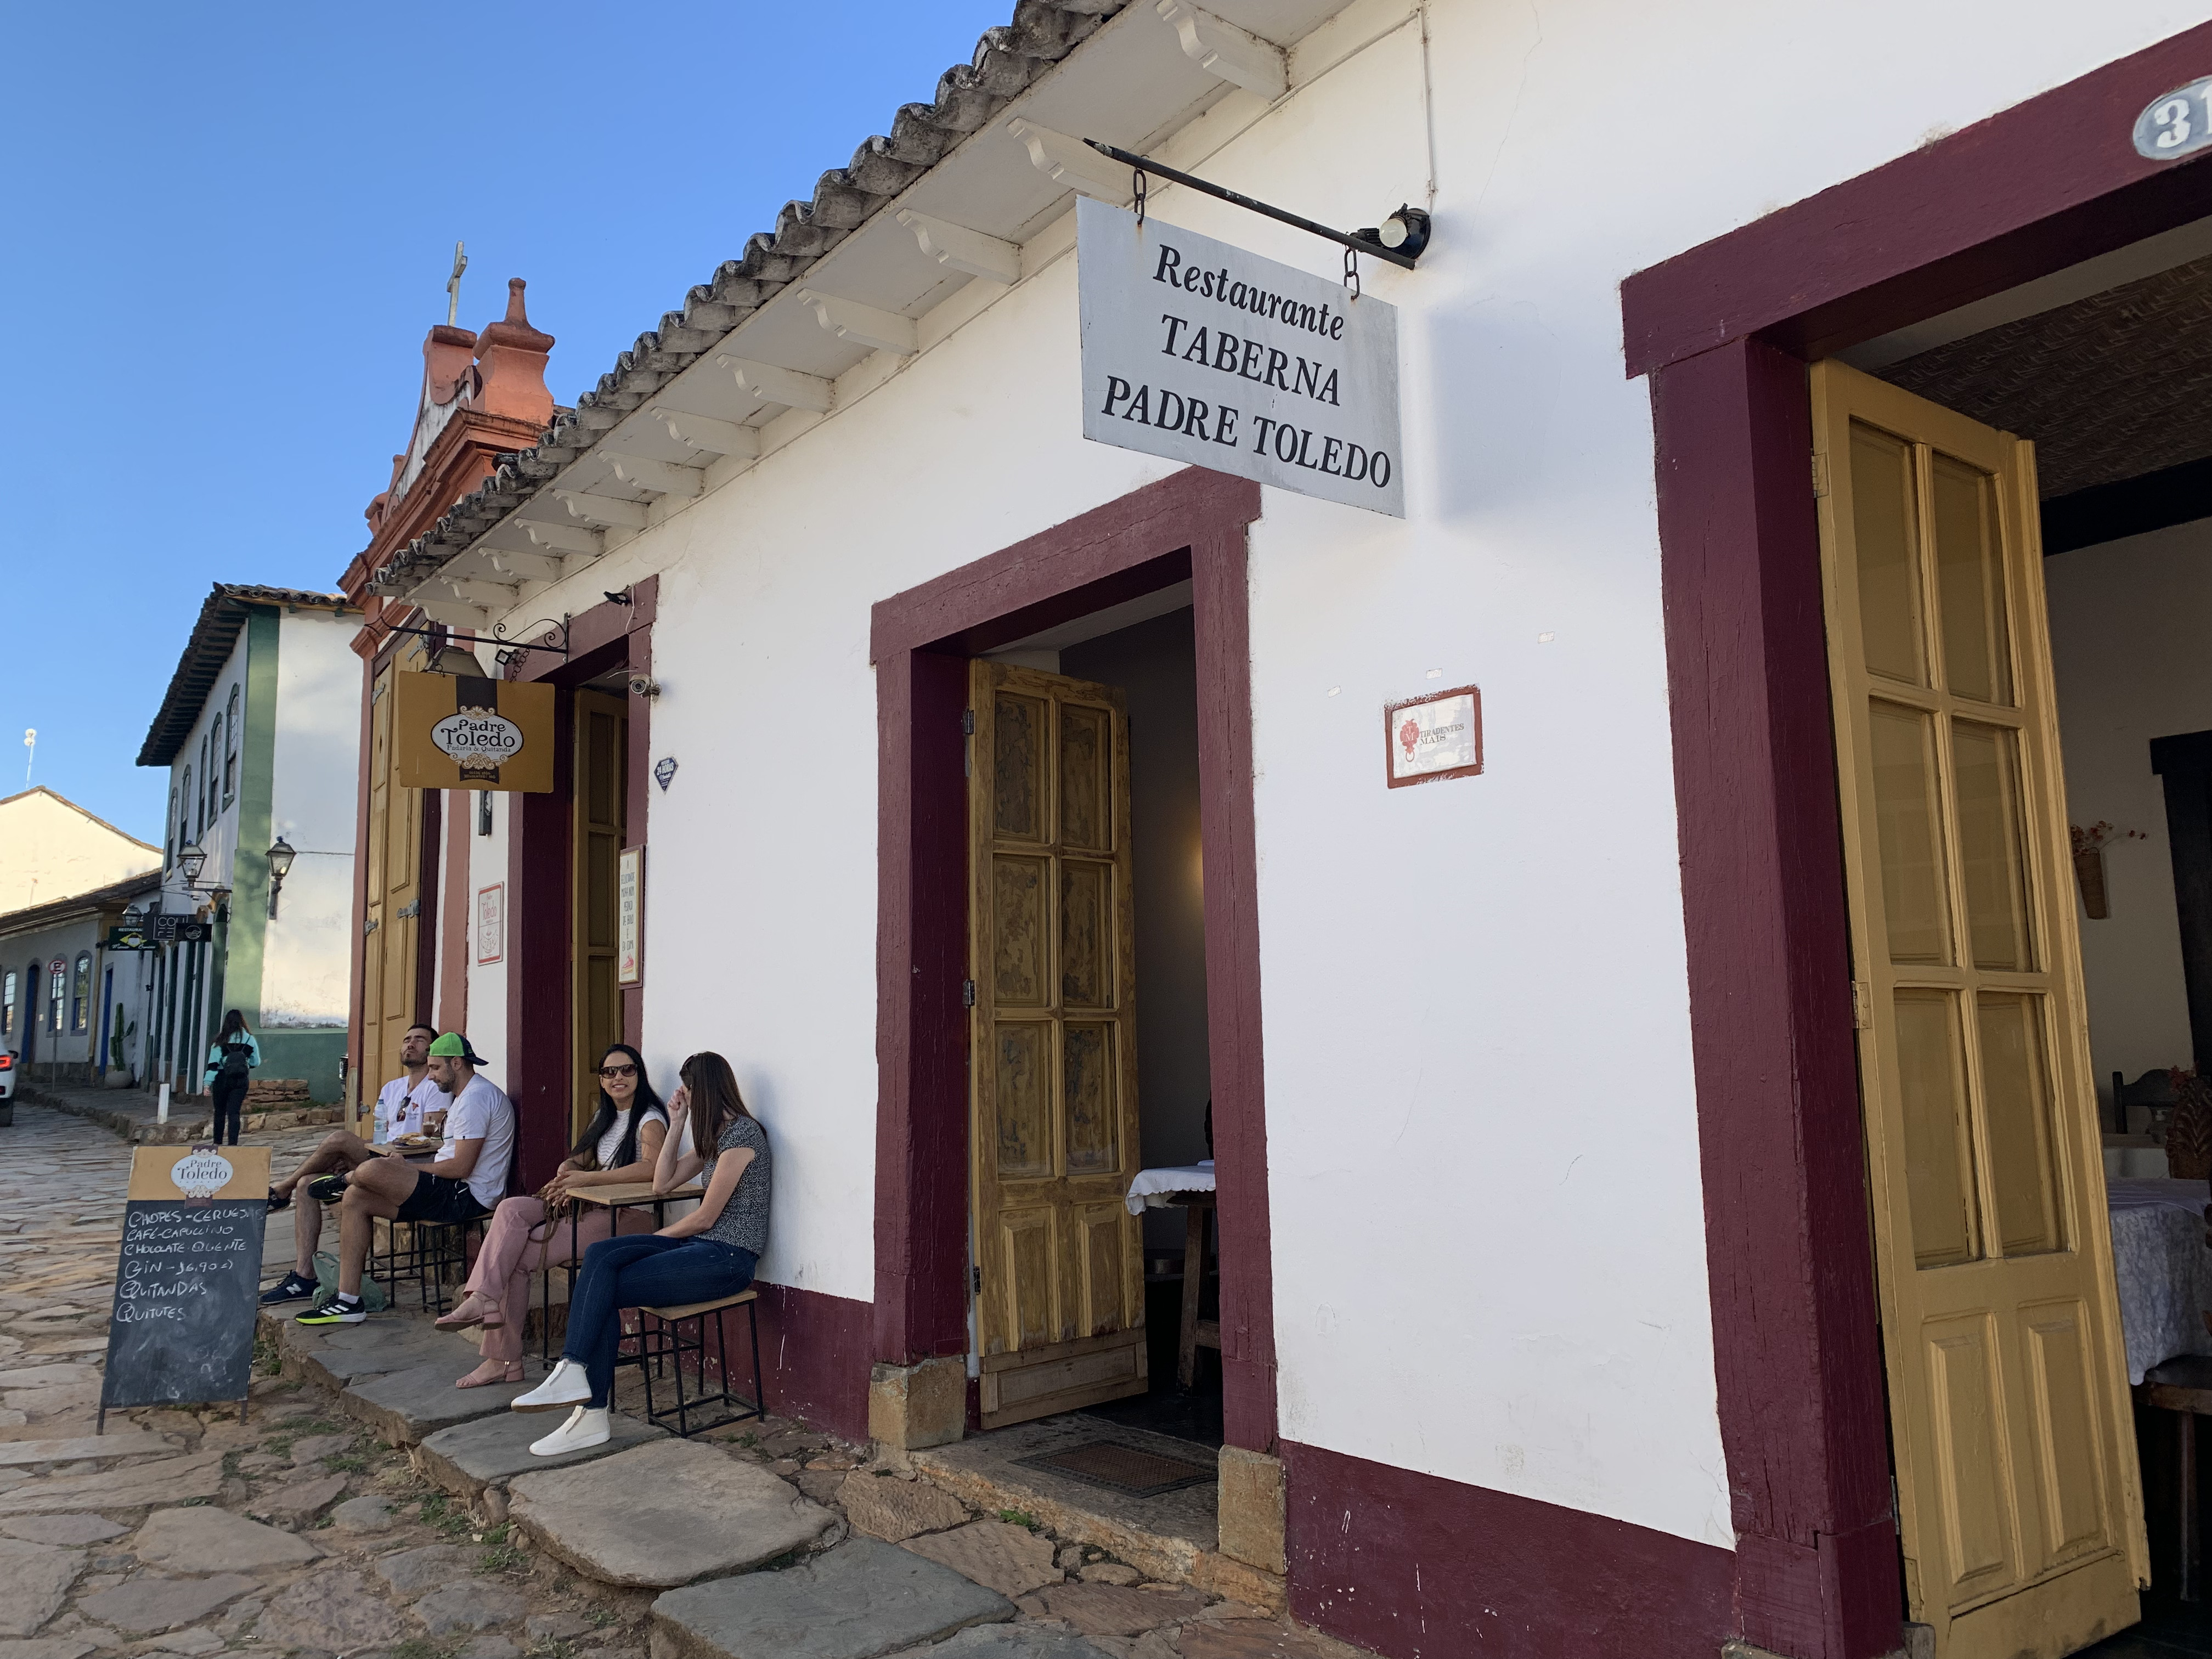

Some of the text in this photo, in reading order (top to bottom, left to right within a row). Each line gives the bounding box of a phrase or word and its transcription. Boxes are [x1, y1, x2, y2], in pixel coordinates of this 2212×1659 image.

[1153, 244, 1344, 341] Restaurante
[1161, 314, 1340, 407] TABERNA
[1102, 375, 1391, 488] PADRE TOLEDO
[459, 719, 505, 732] Padre
[1419, 723, 1464, 738] TIRADENTES
[441, 727, 515, 747] Toledo
[1420, 734, 1446, 745] MAIS
[657, 766, 662, 775] 24
[662, 761, 674, 774] HORAS
[482, 900, 496, 920] Toledo
[190, 1159, 222, 1167] Padre
[178, 1166, 227, 1180] Toledo
[128, 1210, 182, 1227] CHOPES
[124, 1239, 246, 1255] CHOCOLATE QUENTE
[120, 1280, 206, 1299] QUITANDAS
[116, 1302, 185, 1322] QUITUTES
